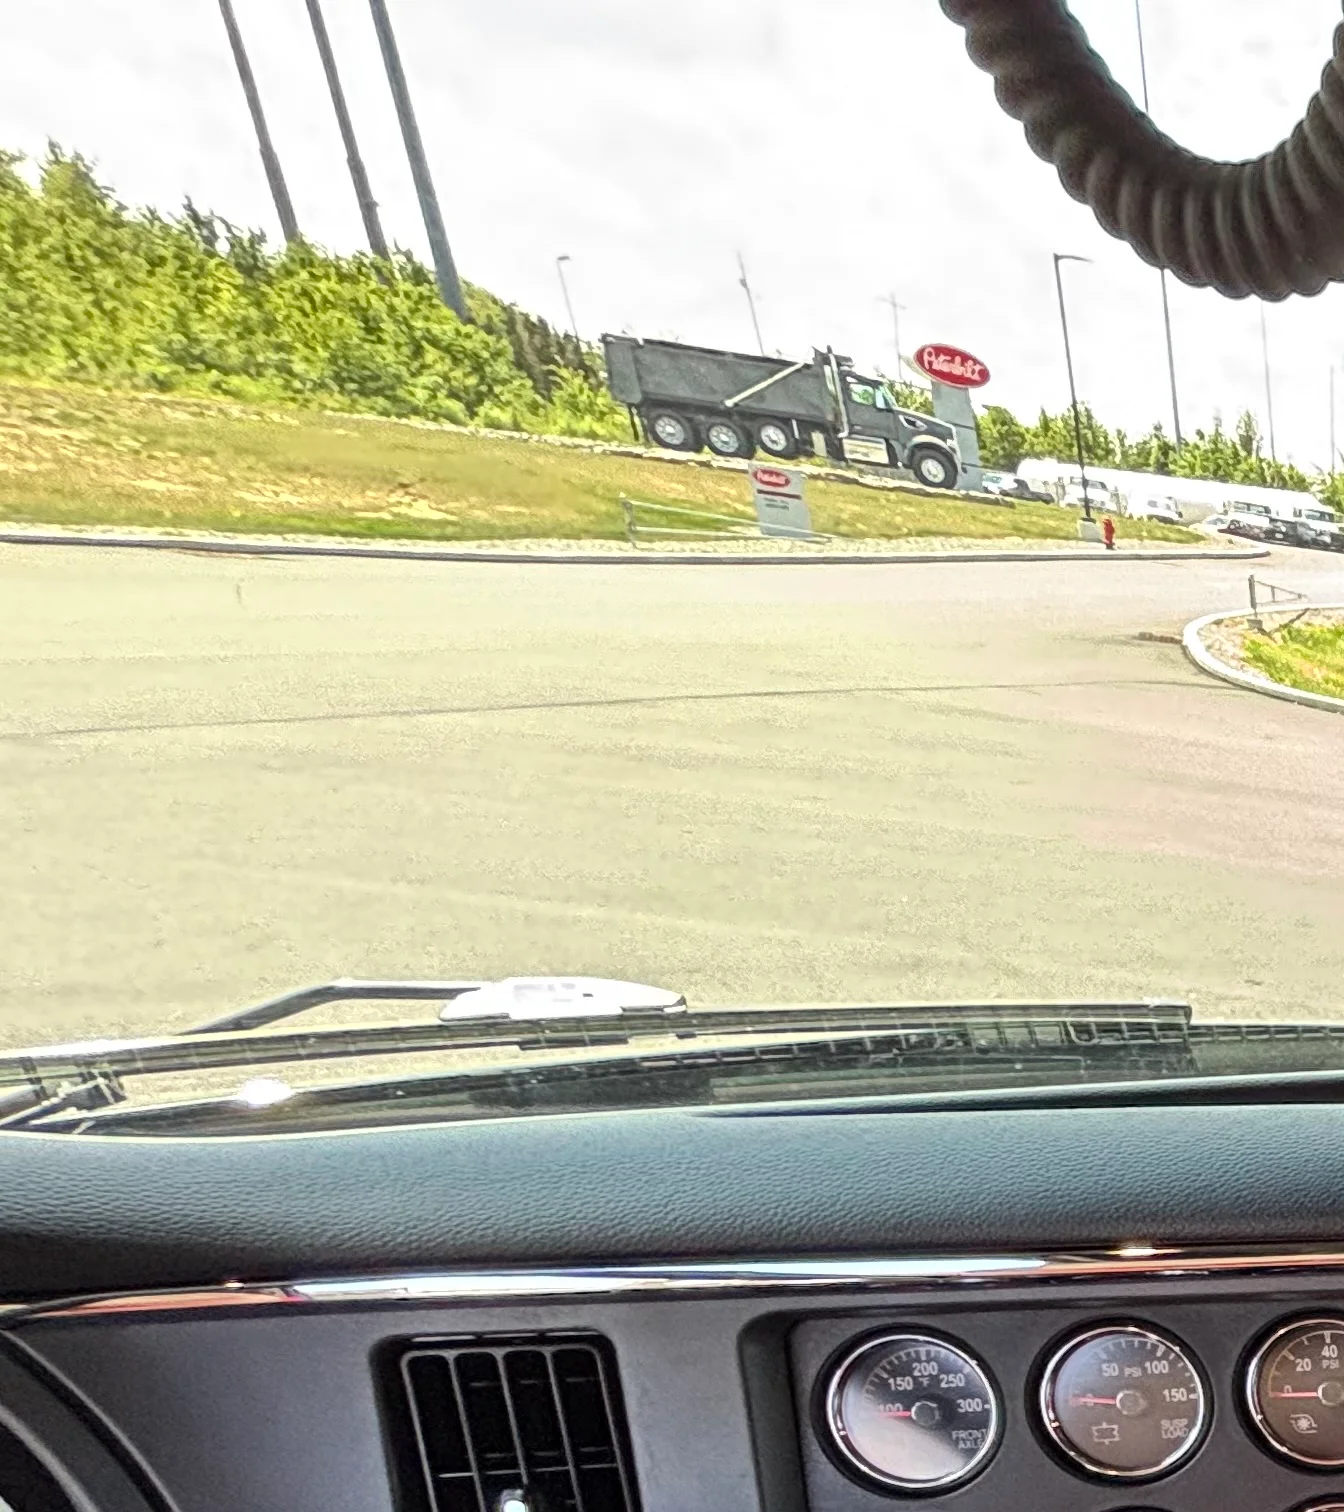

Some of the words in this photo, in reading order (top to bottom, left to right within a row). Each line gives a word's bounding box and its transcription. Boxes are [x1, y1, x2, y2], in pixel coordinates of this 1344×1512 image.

[923, 347, 987, 382] Peterbilt
[1321, 1345, 1338, 1358] 40
[912, 1362, 938, 1376] 200
[1102, 1363, 1119, 1376] 50
[1124, 1366, 1142, 1378] PSI
[1144, 1361, 1169, 1375] 100
[1296, 1358, 1312, 1372] 20
[1322, 1360, 1339, 1370] PSI
[888, 1376, 914, 1391] 150
[939, 1374, 965, 1388] 250
[1163, 1388, 1187, 1402] 150
[956, 1398, 982, 1413] 300
[1160, 1418, 1188, 1430] SUSP
[952, 1429, 987, 1440] FRONT
[1161, 1428, 1190, 1440] LOAD
